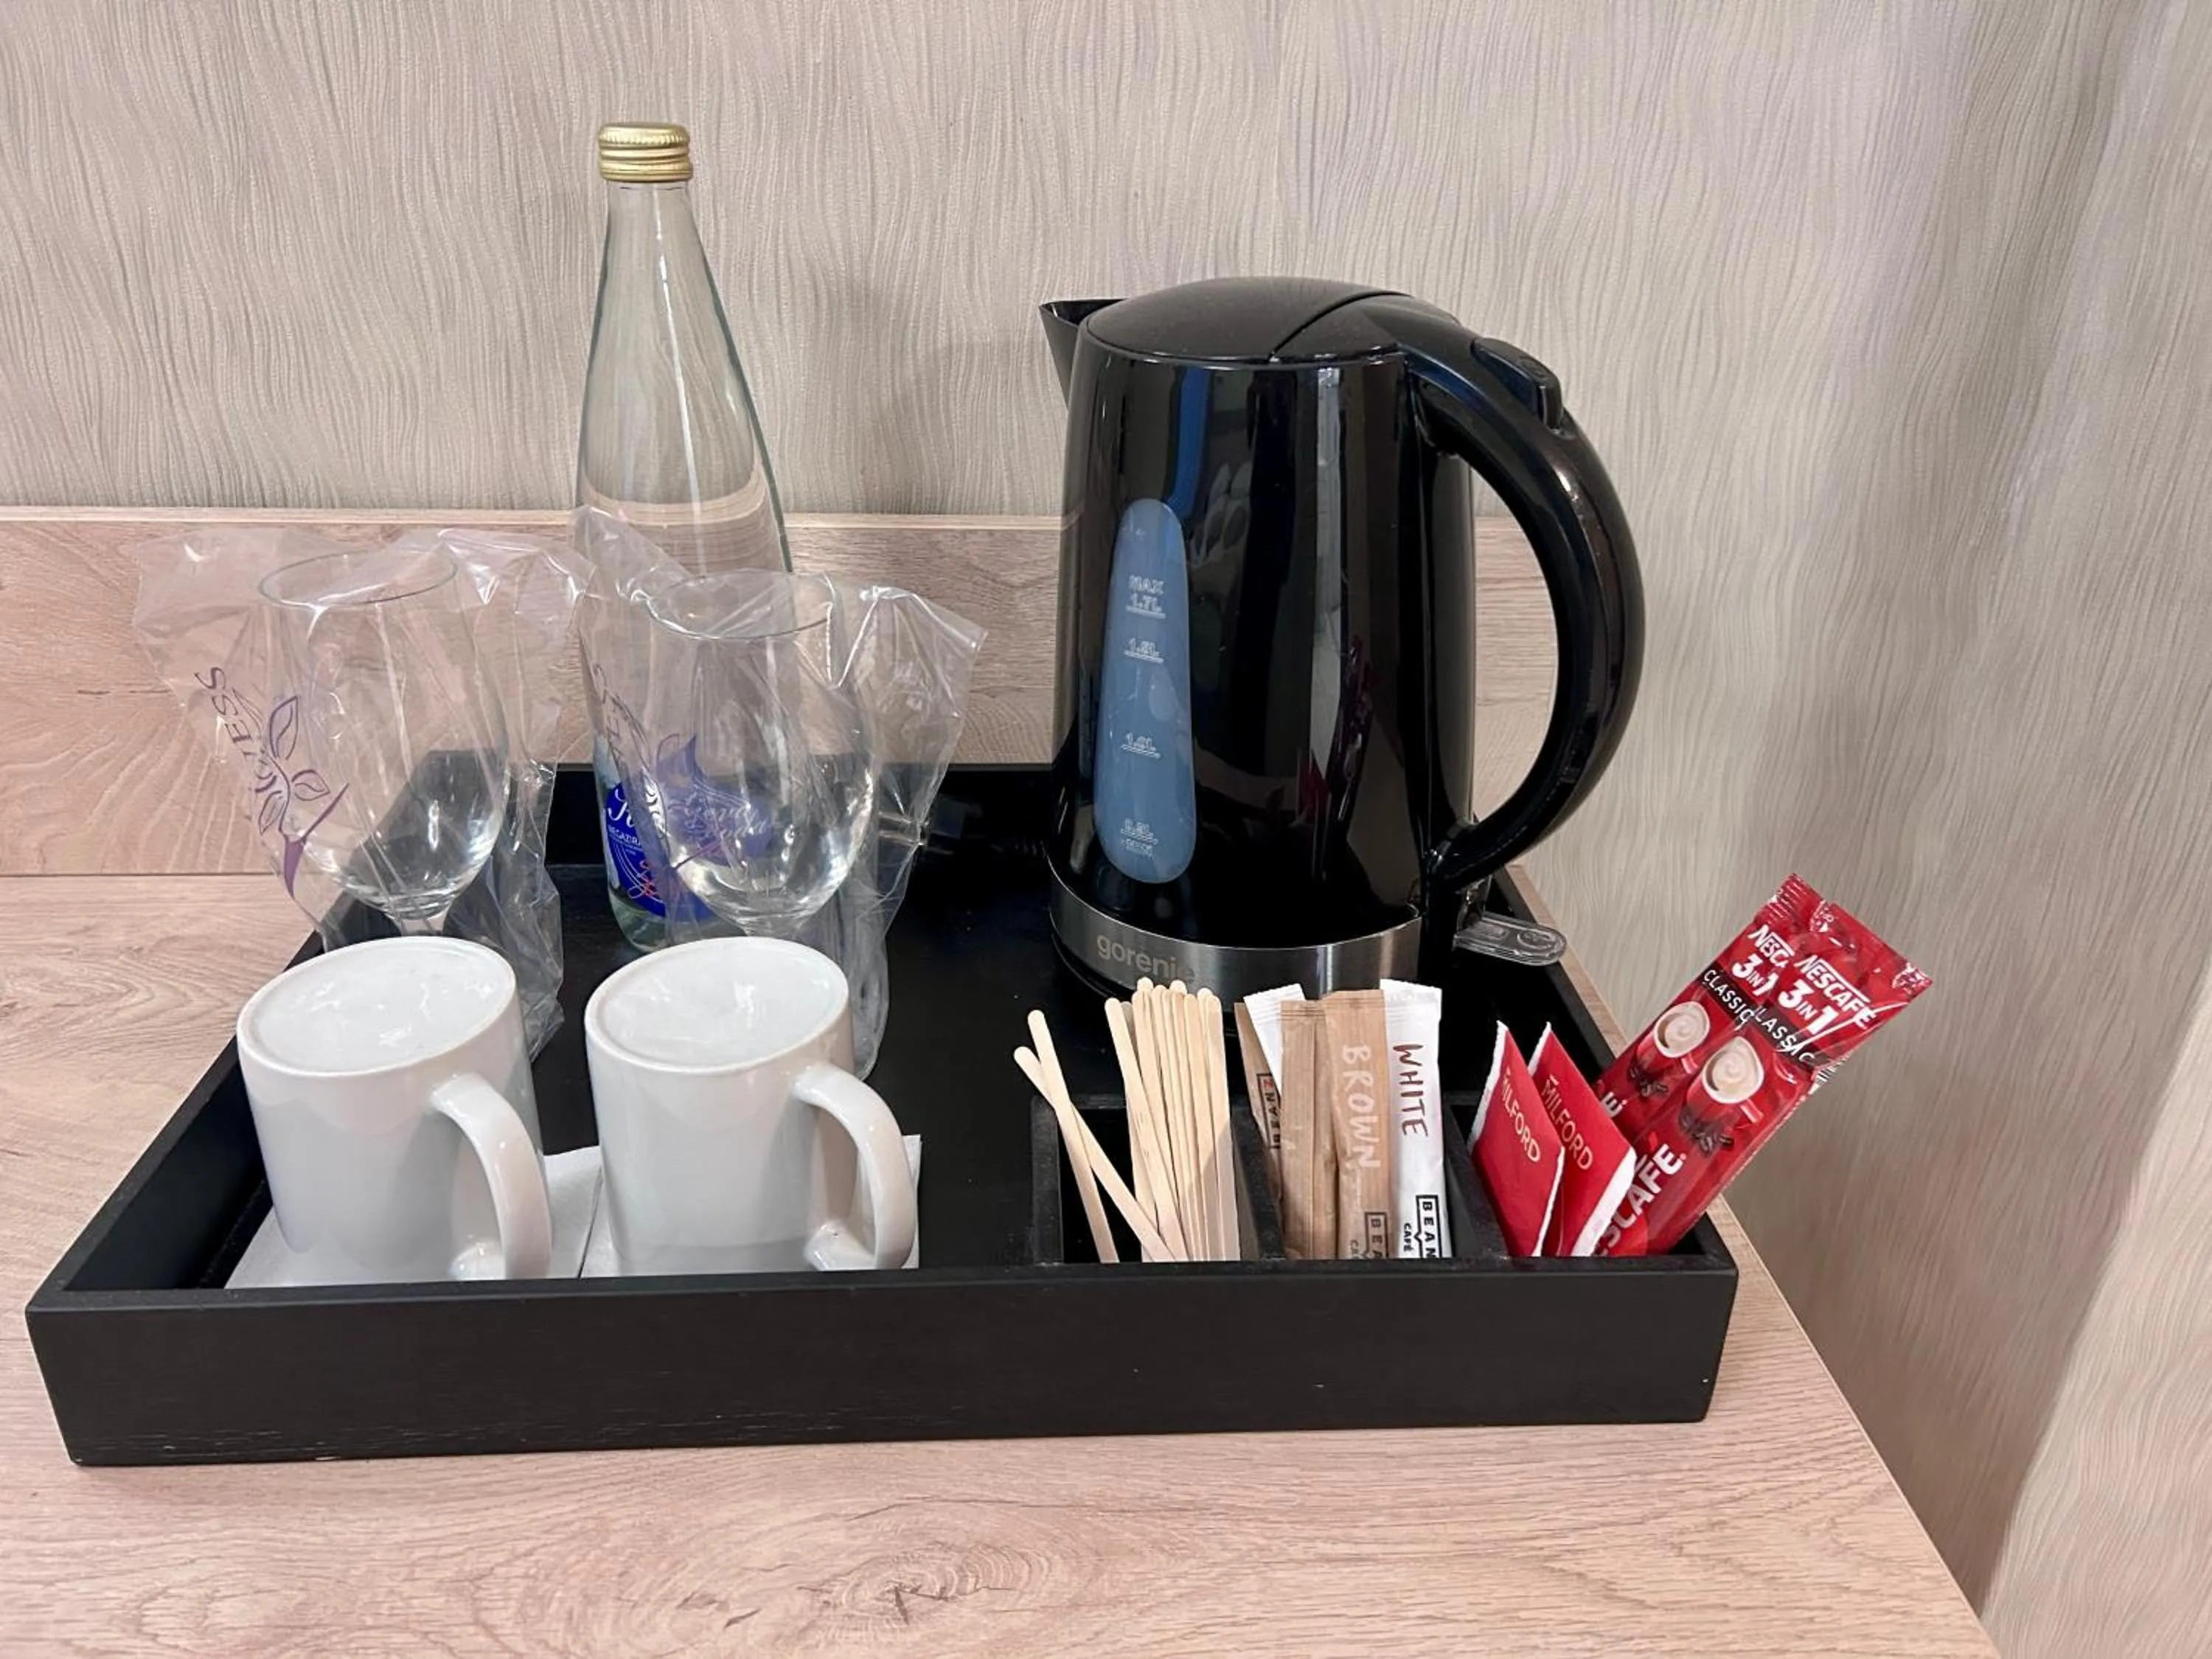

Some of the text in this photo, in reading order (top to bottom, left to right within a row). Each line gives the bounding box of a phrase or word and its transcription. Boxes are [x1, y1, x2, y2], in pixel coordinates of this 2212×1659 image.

[1753, 1005, 1815, 1063] LASSIC
[1342, 1044, 1381, 1167] BROWN
[1392, 1043, 1428, 1137] WHITE
[1541, 1077, 1593, 1170] MILFORD
